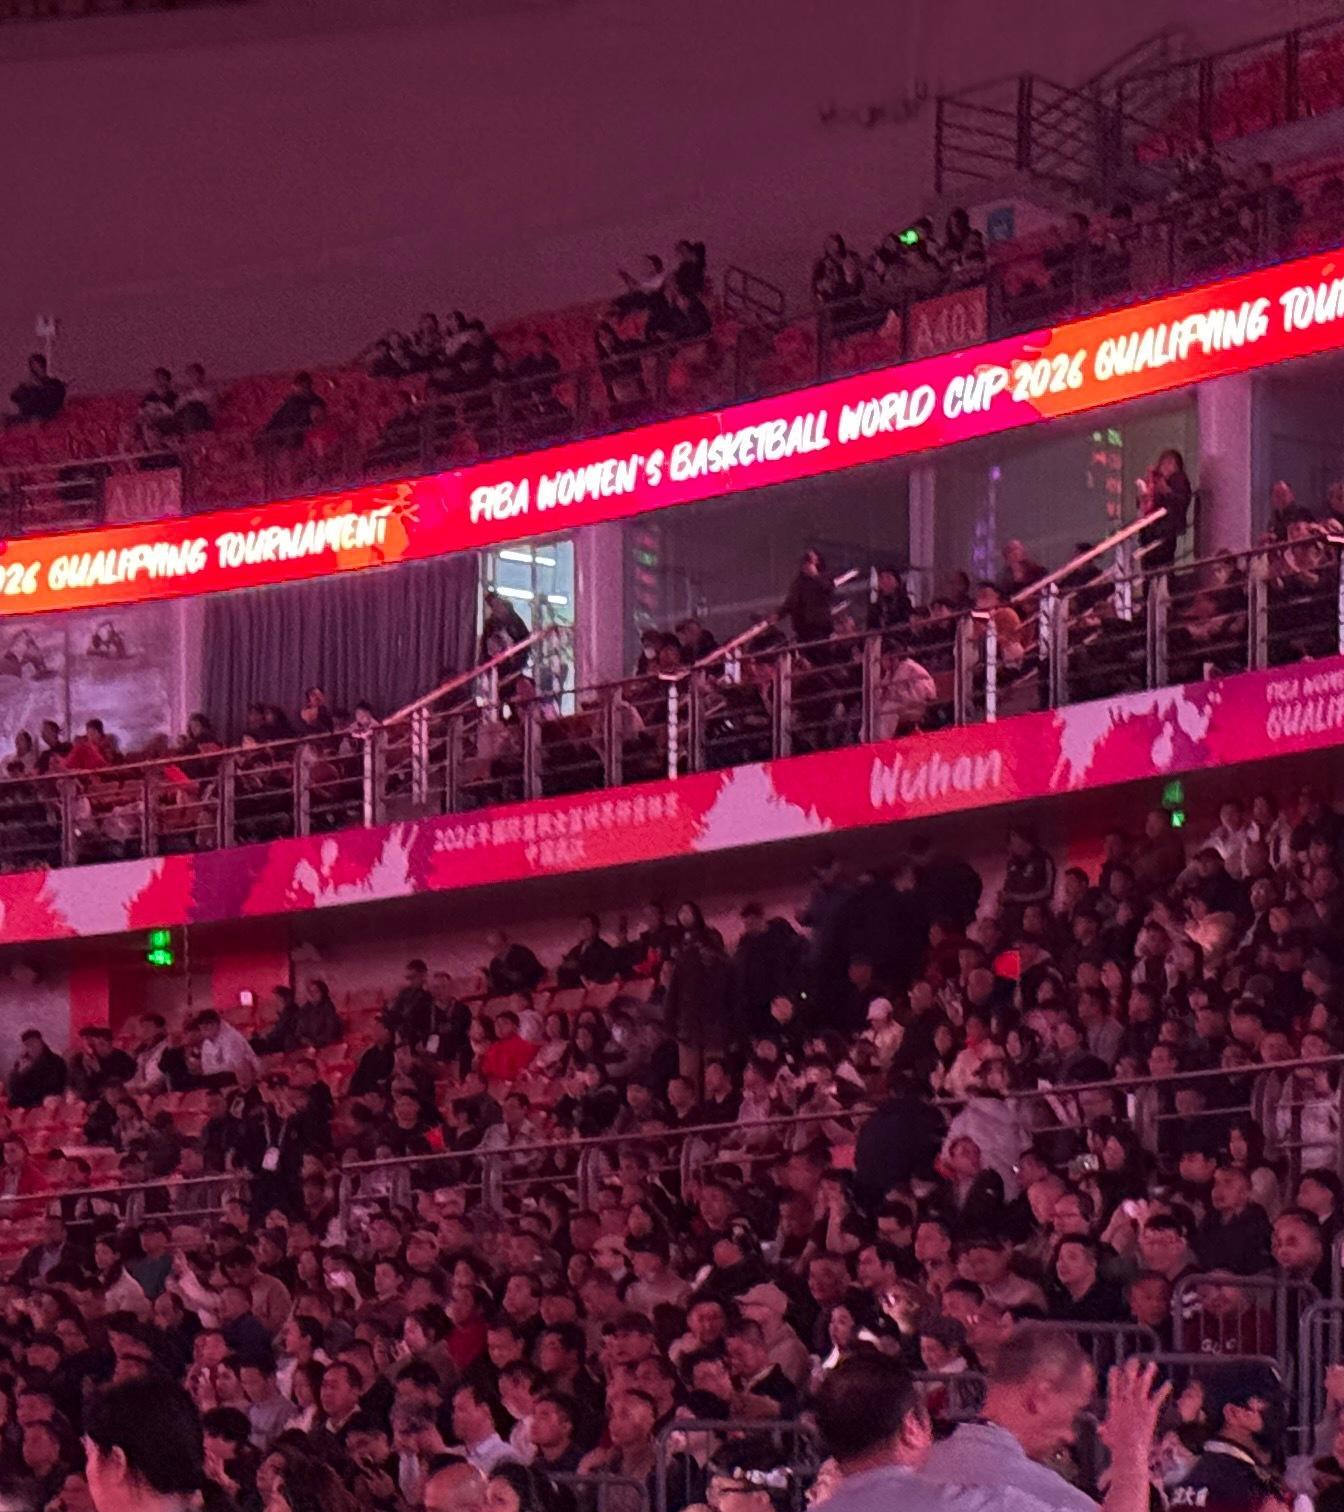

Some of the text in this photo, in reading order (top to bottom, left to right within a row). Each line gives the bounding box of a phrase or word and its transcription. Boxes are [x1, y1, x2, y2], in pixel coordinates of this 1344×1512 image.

[470, 479, 529, 523] FIBA
[536, 449, 665, 510] WOMEN'S
[669, 410, 829, 482] BASKETBALL
[837, 384, 936, 443] WORLD
[942, 367, 1009, 419] CUP
[1011, 348, 1083, 403] 2026
[1093, 297, 1270, 382] QUALIFYING
[47, 538, 207, 593] QUALIFYING
[215, 505, 395, 569] TOURNAMENT
[868, 747, 1003, 811] Wuhan
